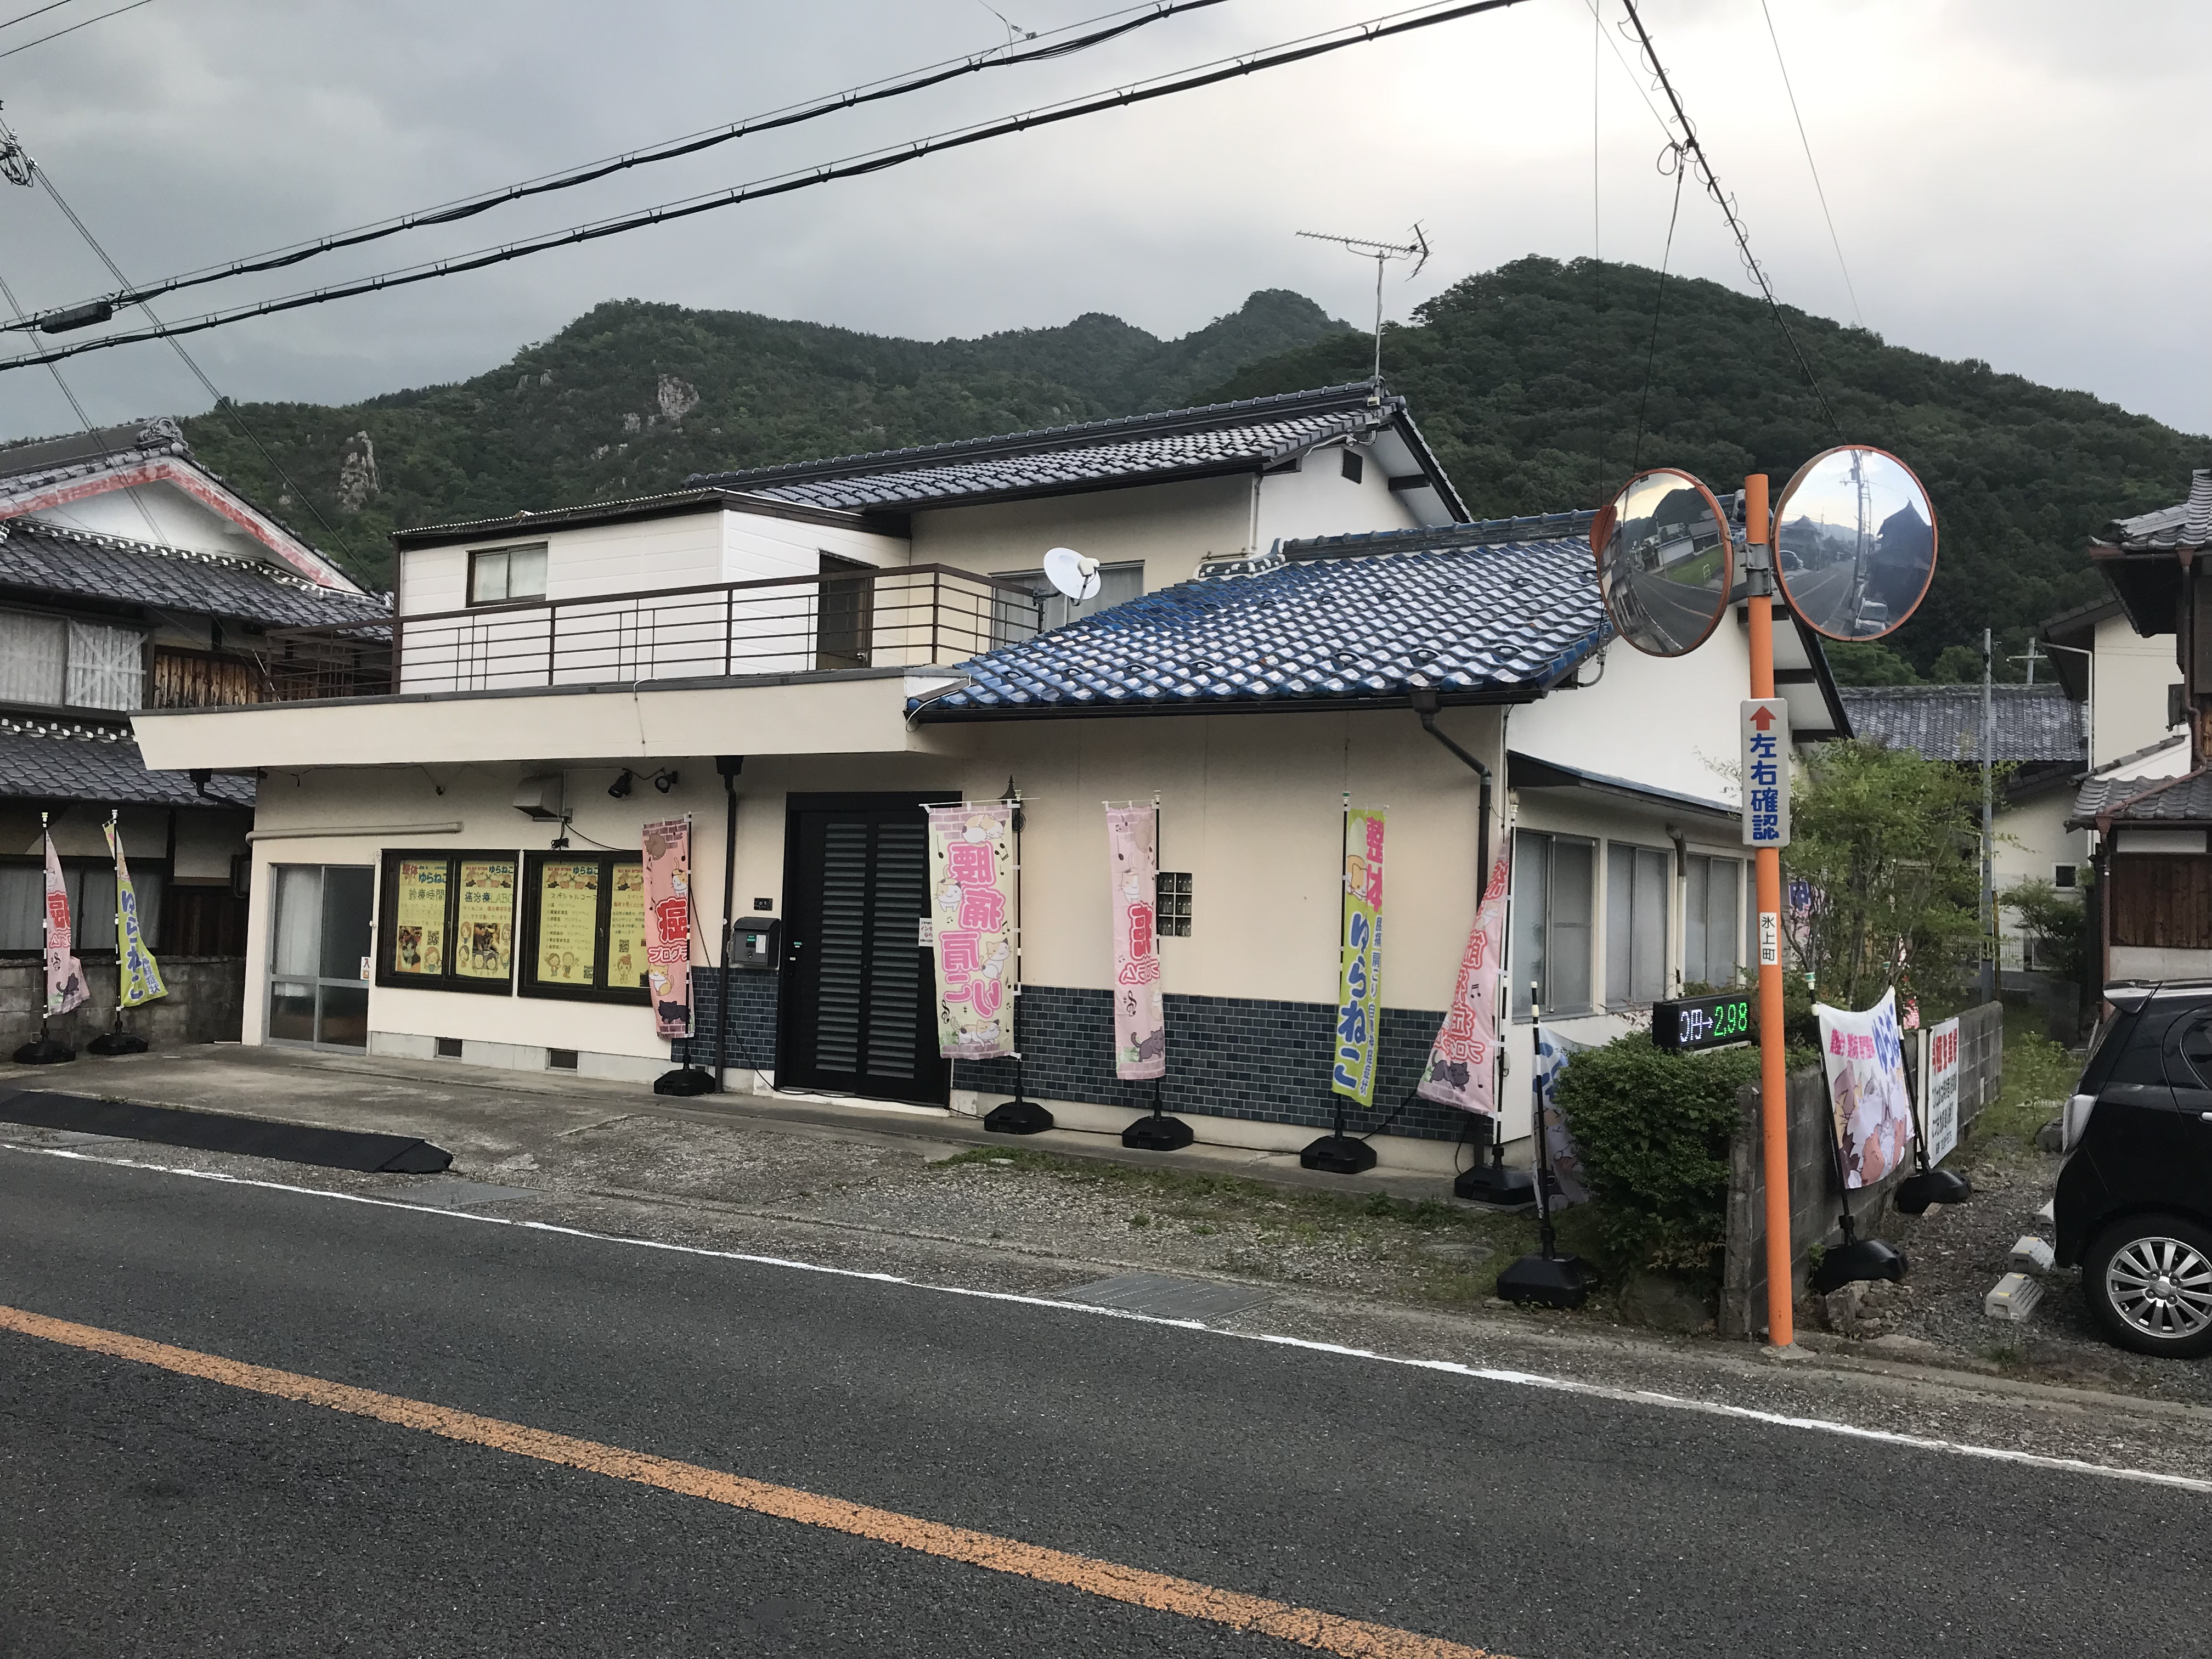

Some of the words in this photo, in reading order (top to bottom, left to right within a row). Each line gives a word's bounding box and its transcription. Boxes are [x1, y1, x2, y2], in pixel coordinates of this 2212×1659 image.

[1750, 733, 1779, 840] 左右確認
[419, 872, 447, 884] ゆらねこ
[489, 865, 514, 873] ゆらねこ
[573, 866, 598, 874] ゆらねこ
[409, 888, 445, 901] 診療時間
[656, 898, 687, 942] 癌
[1761, 915, 1776, 962] 氷上町
[1334, 912, 1369, 1089] ゆらねこ
